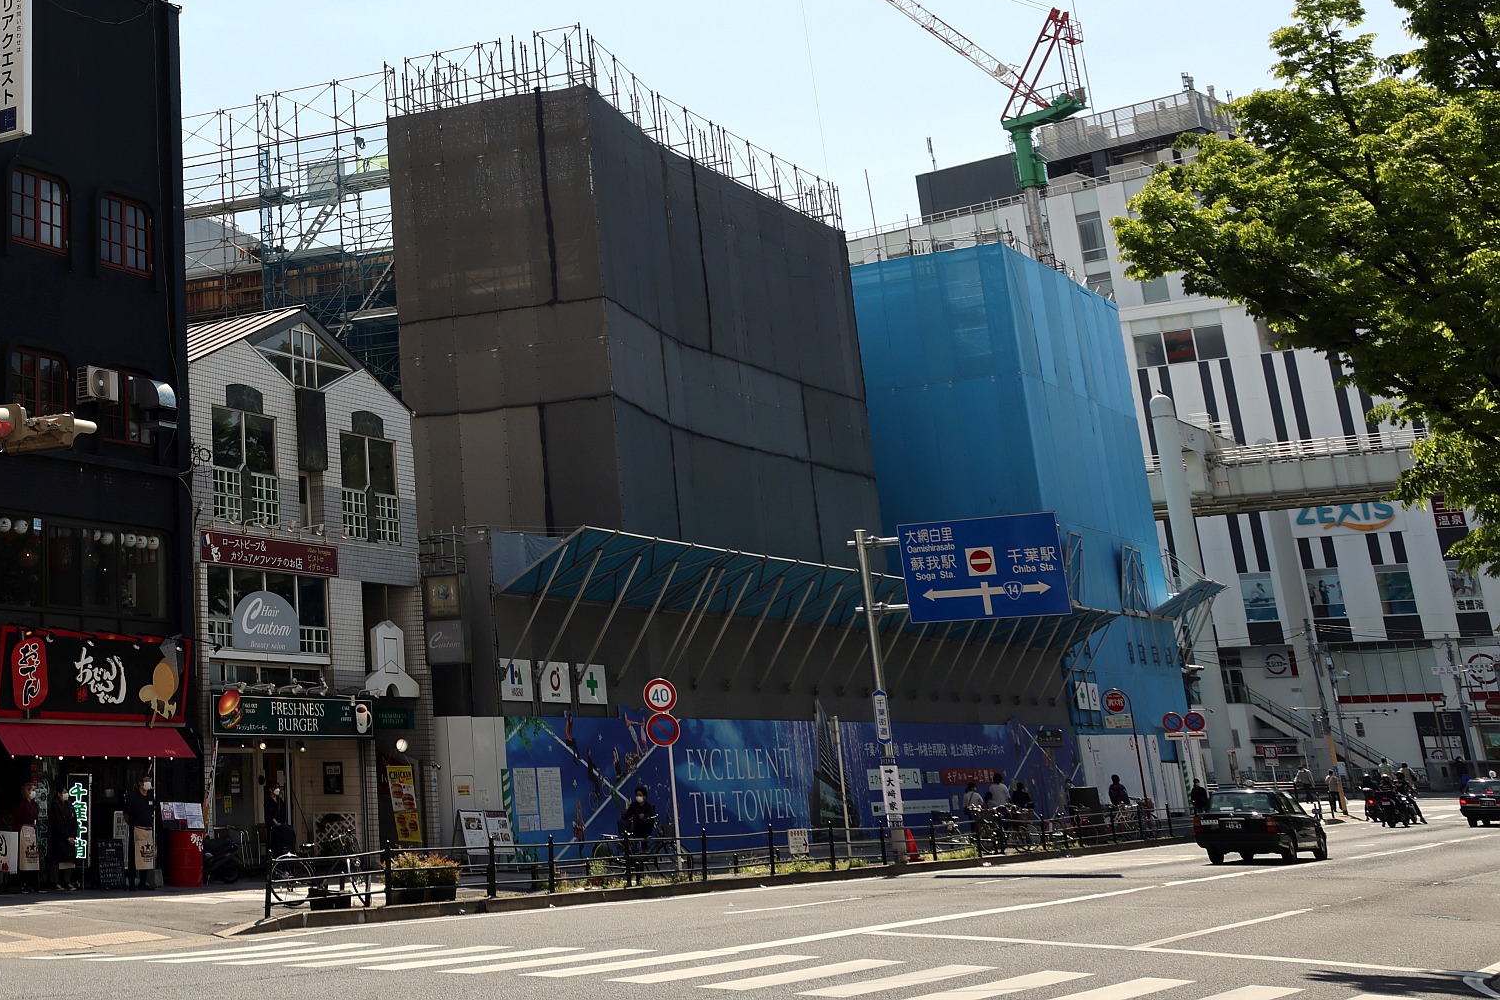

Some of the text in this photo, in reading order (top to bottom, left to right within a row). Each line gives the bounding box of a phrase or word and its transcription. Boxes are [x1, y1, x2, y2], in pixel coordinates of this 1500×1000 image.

[1437, 514, 1464, 526] 温泉
[905, 526, 954, 544] 大網白里
[222, 538, 267, 552] ローストビーフ&
[906, 543, 956, 554] Oamishirasato
[230, 551, 303, 570] カジュアルフレンチのお店
[909, 554, 958, 571] 蘇我駅
[1007, 546, 1057, 564] 千葉駅
[915, 571, 956, 582] Soga Sta.
[1012, 563, 1057, 574] Chiba Sta.
[1007, 585, 1018, 595] 14
[260, 605, 280, 617] Hair
[1456, 600, 1484, 611] 岩盤浴
[241, 597, 302, 636] Custom
[18, 643, 41, 707] おでん
[651, 687, 669, 703] 40
[270, 701, 325, 717] FRESHNESS
[277, 717, 320, 732] BURGER
[876, 699, 888, 736] 千葉街道
[685, 748, 793, 781] EXCELLENT
[688, 788, 797, 824] THE TOWER
